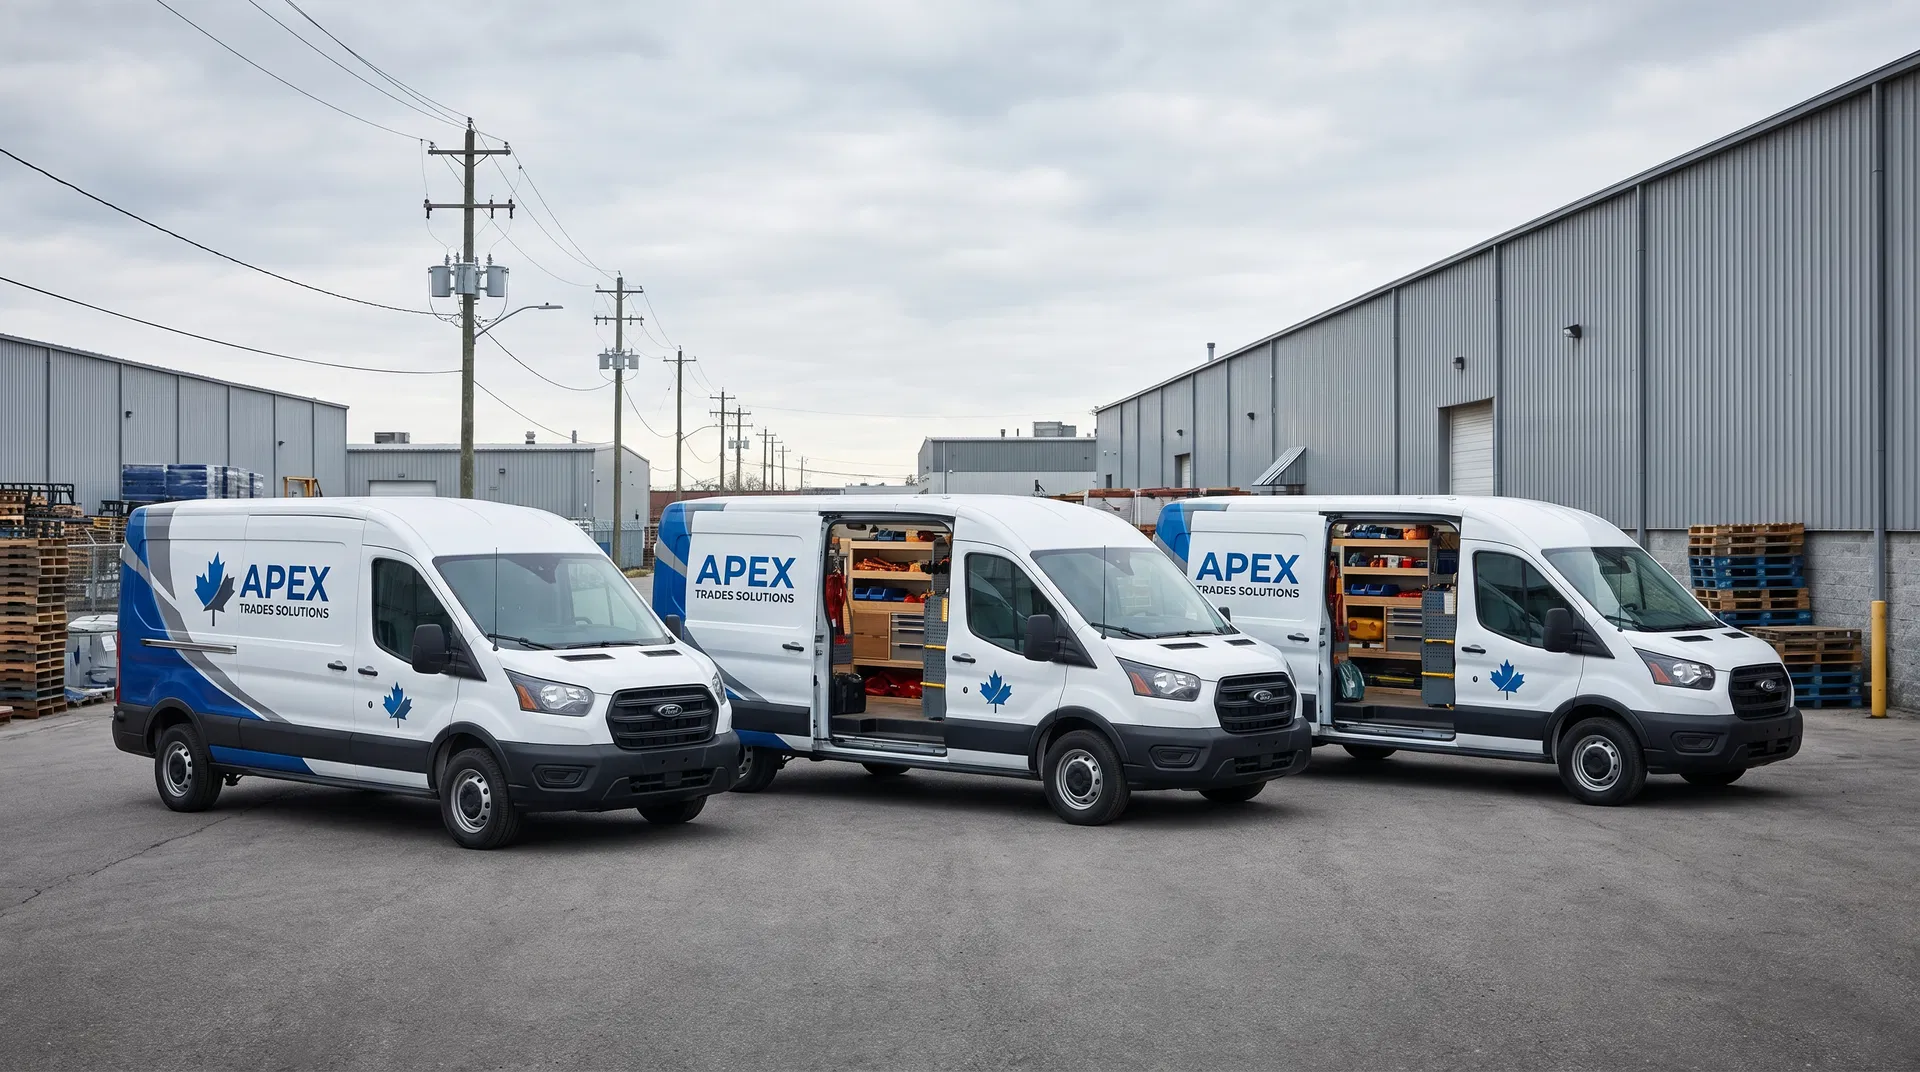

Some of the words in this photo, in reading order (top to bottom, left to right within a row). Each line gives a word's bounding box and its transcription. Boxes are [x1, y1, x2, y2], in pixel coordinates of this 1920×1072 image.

[695, 554, 796, 589] APEX
[1196, 552, 1300, 584] APEX
[239, 564, 331, 602] APEX
[1197, 585, 1236, 595] TRADES
[1238, 586, 1300, 598] SOLUTIONS
[695, 589, 734, 600] TRADES
[736, 591, 795, 603] SOLUTIONS
[239, 603, 274, 615] TRADES
[275, 605, 329, 619] SOLUTIONS
